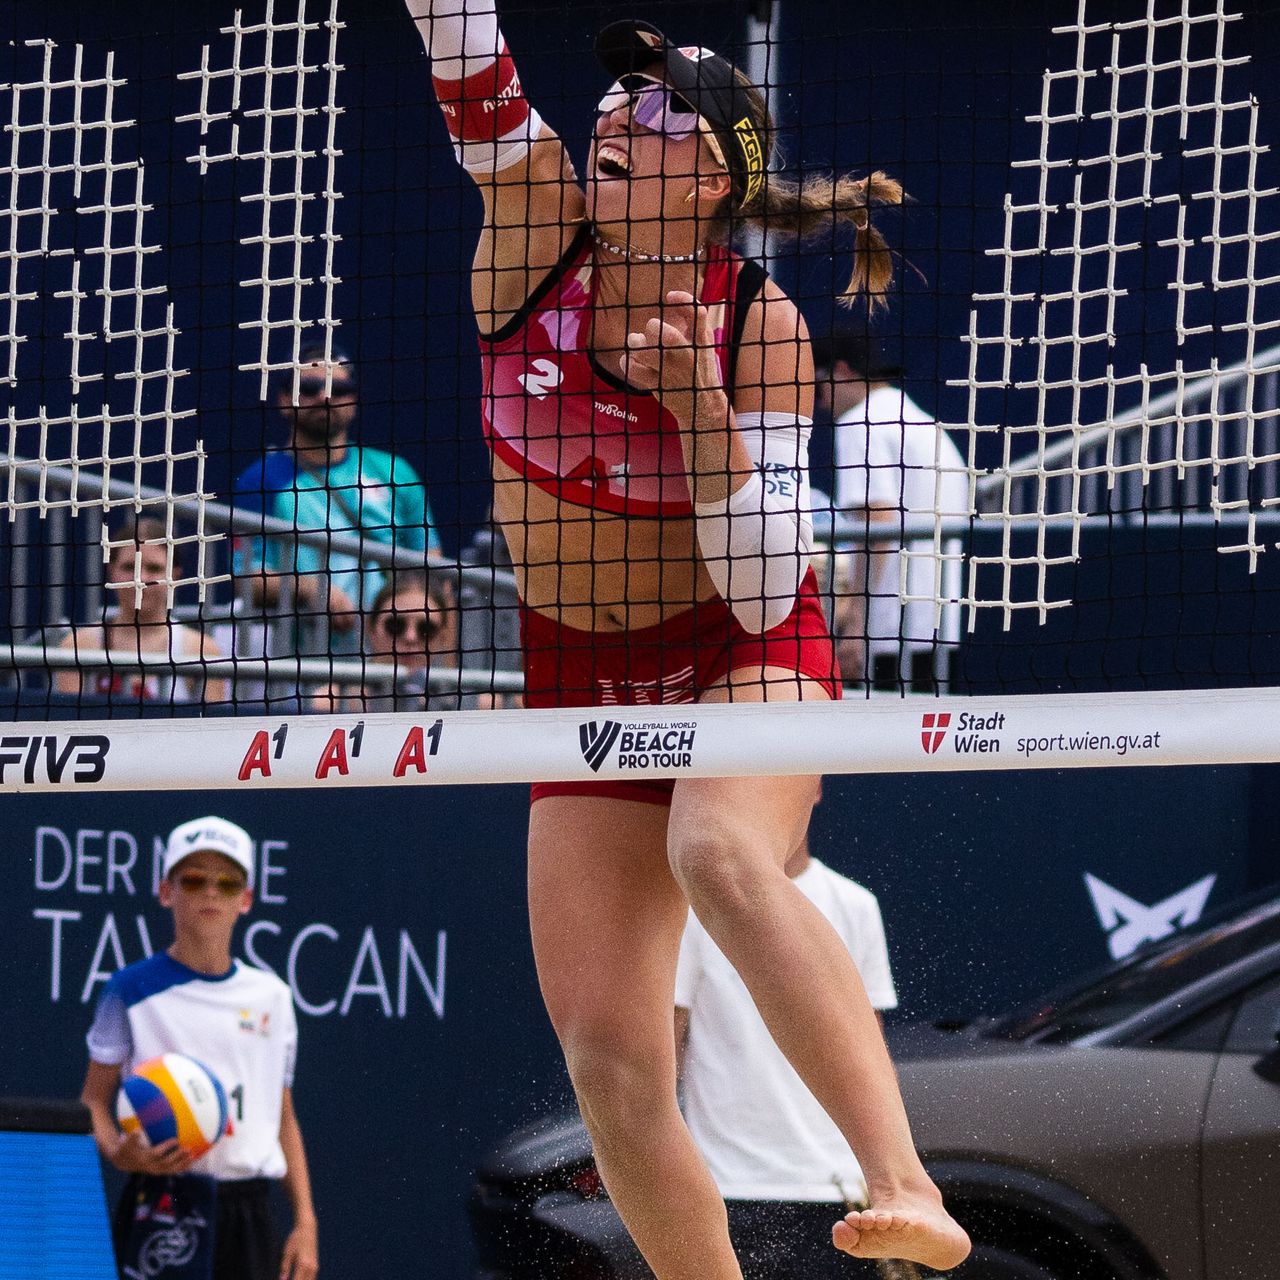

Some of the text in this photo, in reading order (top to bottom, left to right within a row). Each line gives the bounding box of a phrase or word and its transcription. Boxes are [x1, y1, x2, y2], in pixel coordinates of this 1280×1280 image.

[517, 357, 565, 401] 2
[623, 721, 698, 731] VOLLEYBALL WORLD
[956, 711, 1006, 732] Stadt
[237, 722, 289, 781] A1
[314, 720, 365, 780] A1
[392, 718, 444, 778] A1
[619, 730, 696, 753] BEACH
[953, 734, 1001, 754] Wien
[1016, 730, 1161, 758] sport.wien.gv.at
[618, 752, 692, 769] PRO TOUR
[33, 825, 139, 896] DER
[32, 908, 447, 1020] TASCAN
